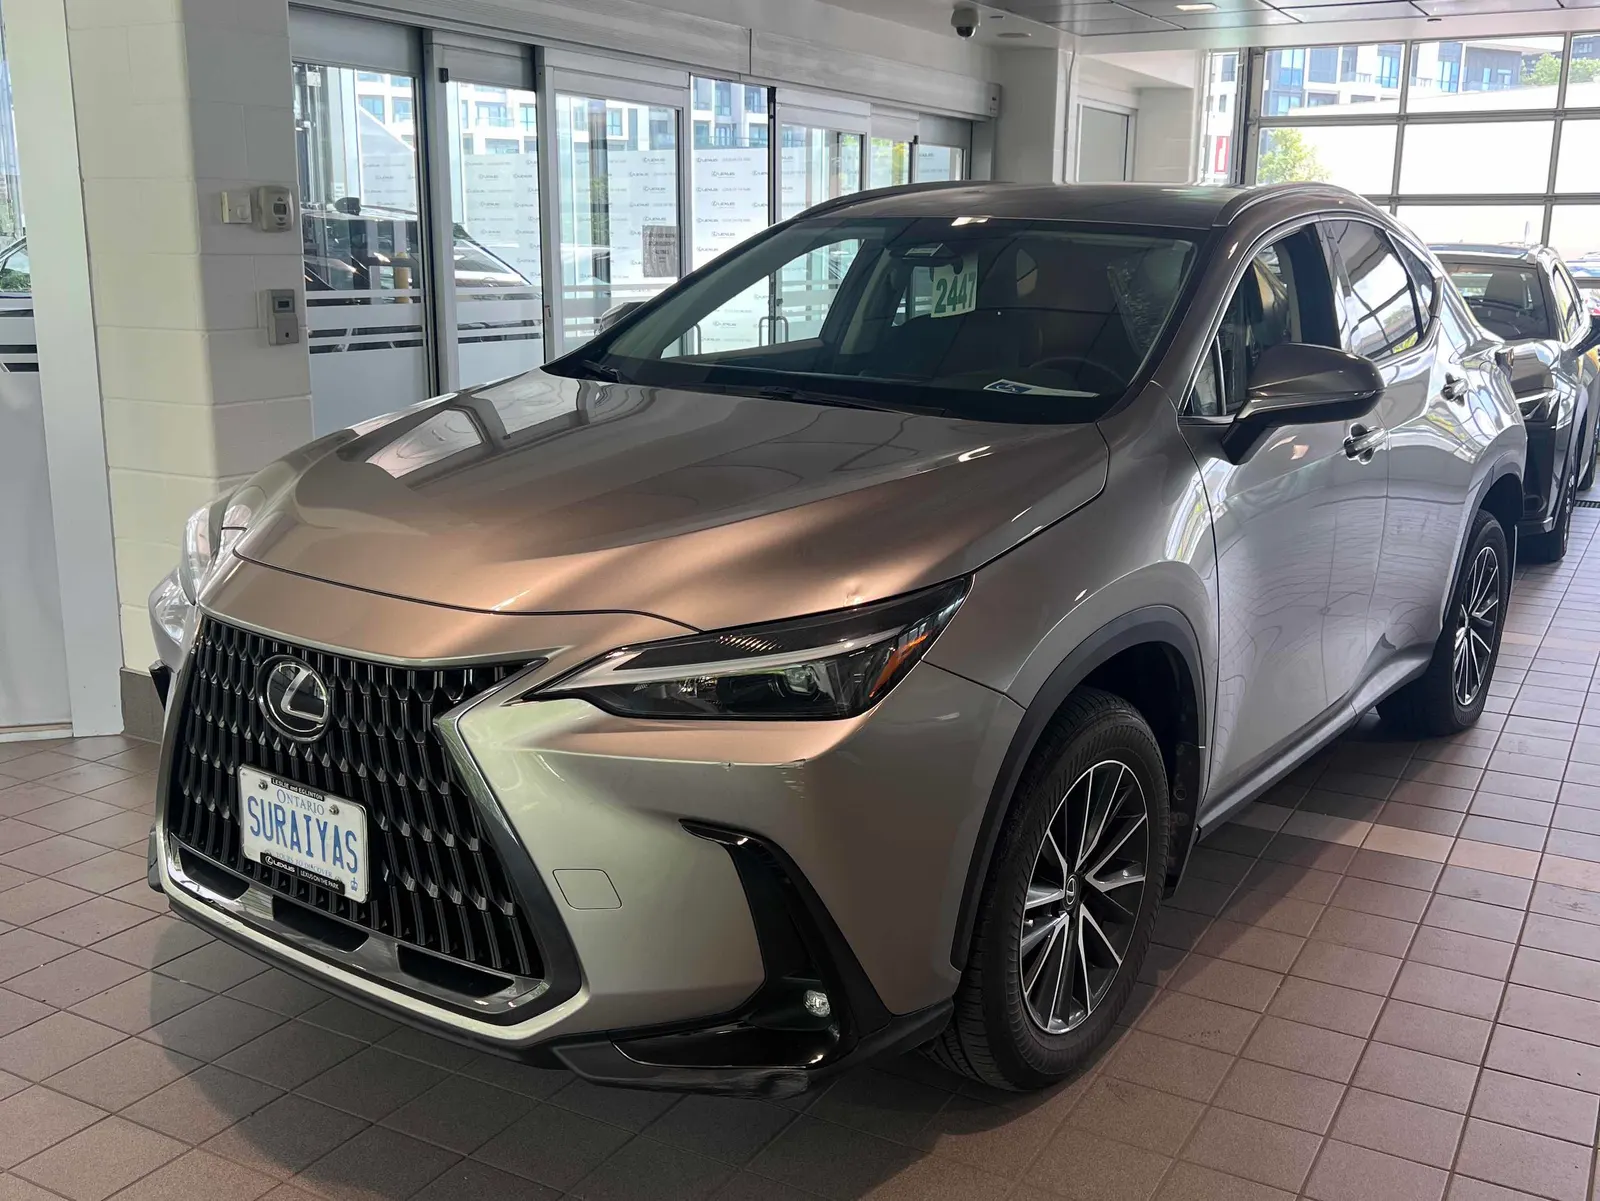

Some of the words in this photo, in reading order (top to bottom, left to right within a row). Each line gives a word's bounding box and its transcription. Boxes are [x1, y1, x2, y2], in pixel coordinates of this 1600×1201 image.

[934, 272, 976, 314] 2447
[299, 787, 323, 800] EGLINTON
[247, 796, 358, 873] SURAIYAS
[274, 861, 295, 872] LEXUS
[304, 862, 332, 877] DISCOVER
[300, 870, 313, 880] LEXUS
[320, 877, 328, 885] THE
[328, 881, 339, 889] PARK
